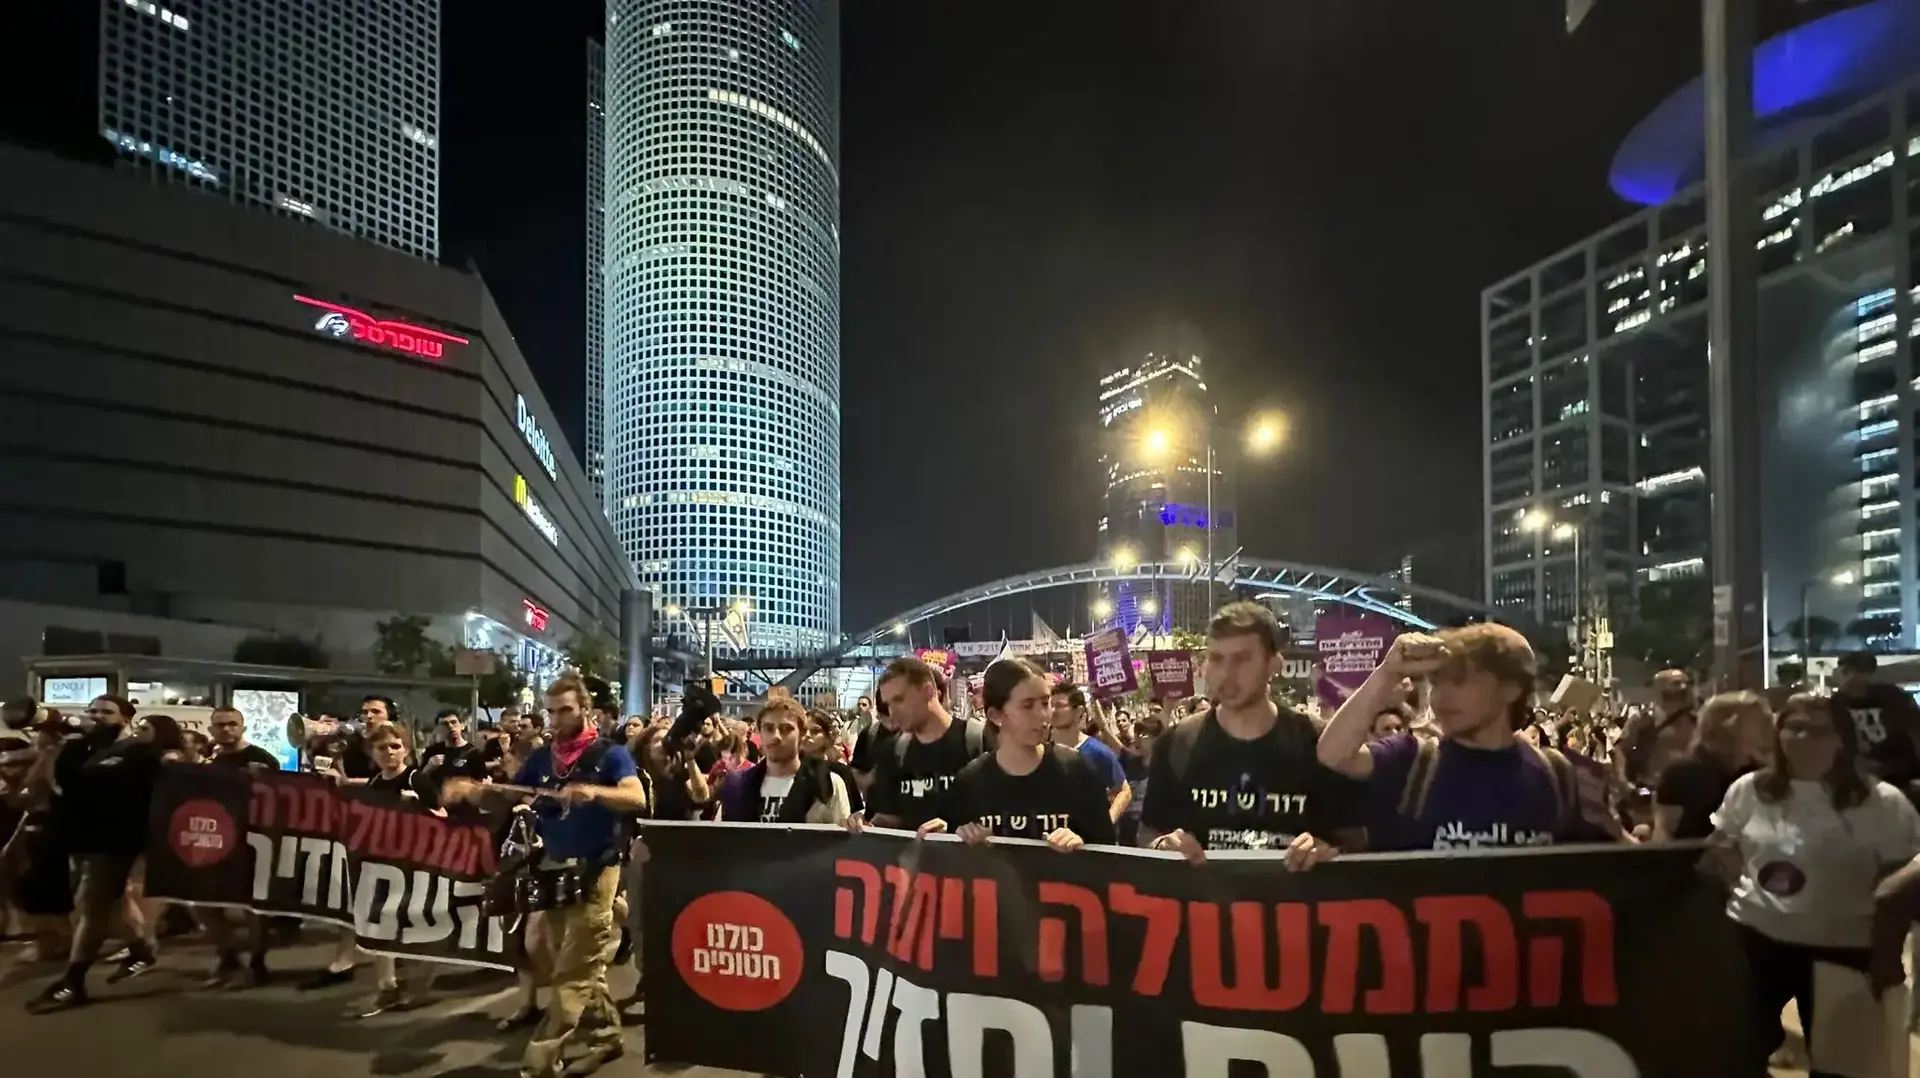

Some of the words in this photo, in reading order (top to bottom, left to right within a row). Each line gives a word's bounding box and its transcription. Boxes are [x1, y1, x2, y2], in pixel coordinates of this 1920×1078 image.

[351, 318, 443, 358] שופרסל
[1266, 792, 1308, 814] דור
[348, 800, 500, 877] הממשל
[246, 831, 356, 915] חזיר
[707, 922, 764, 951] כולנו
[1039, 881, 1619, 1014] הממשלה
[693, 948, 781, 981] חטופים
